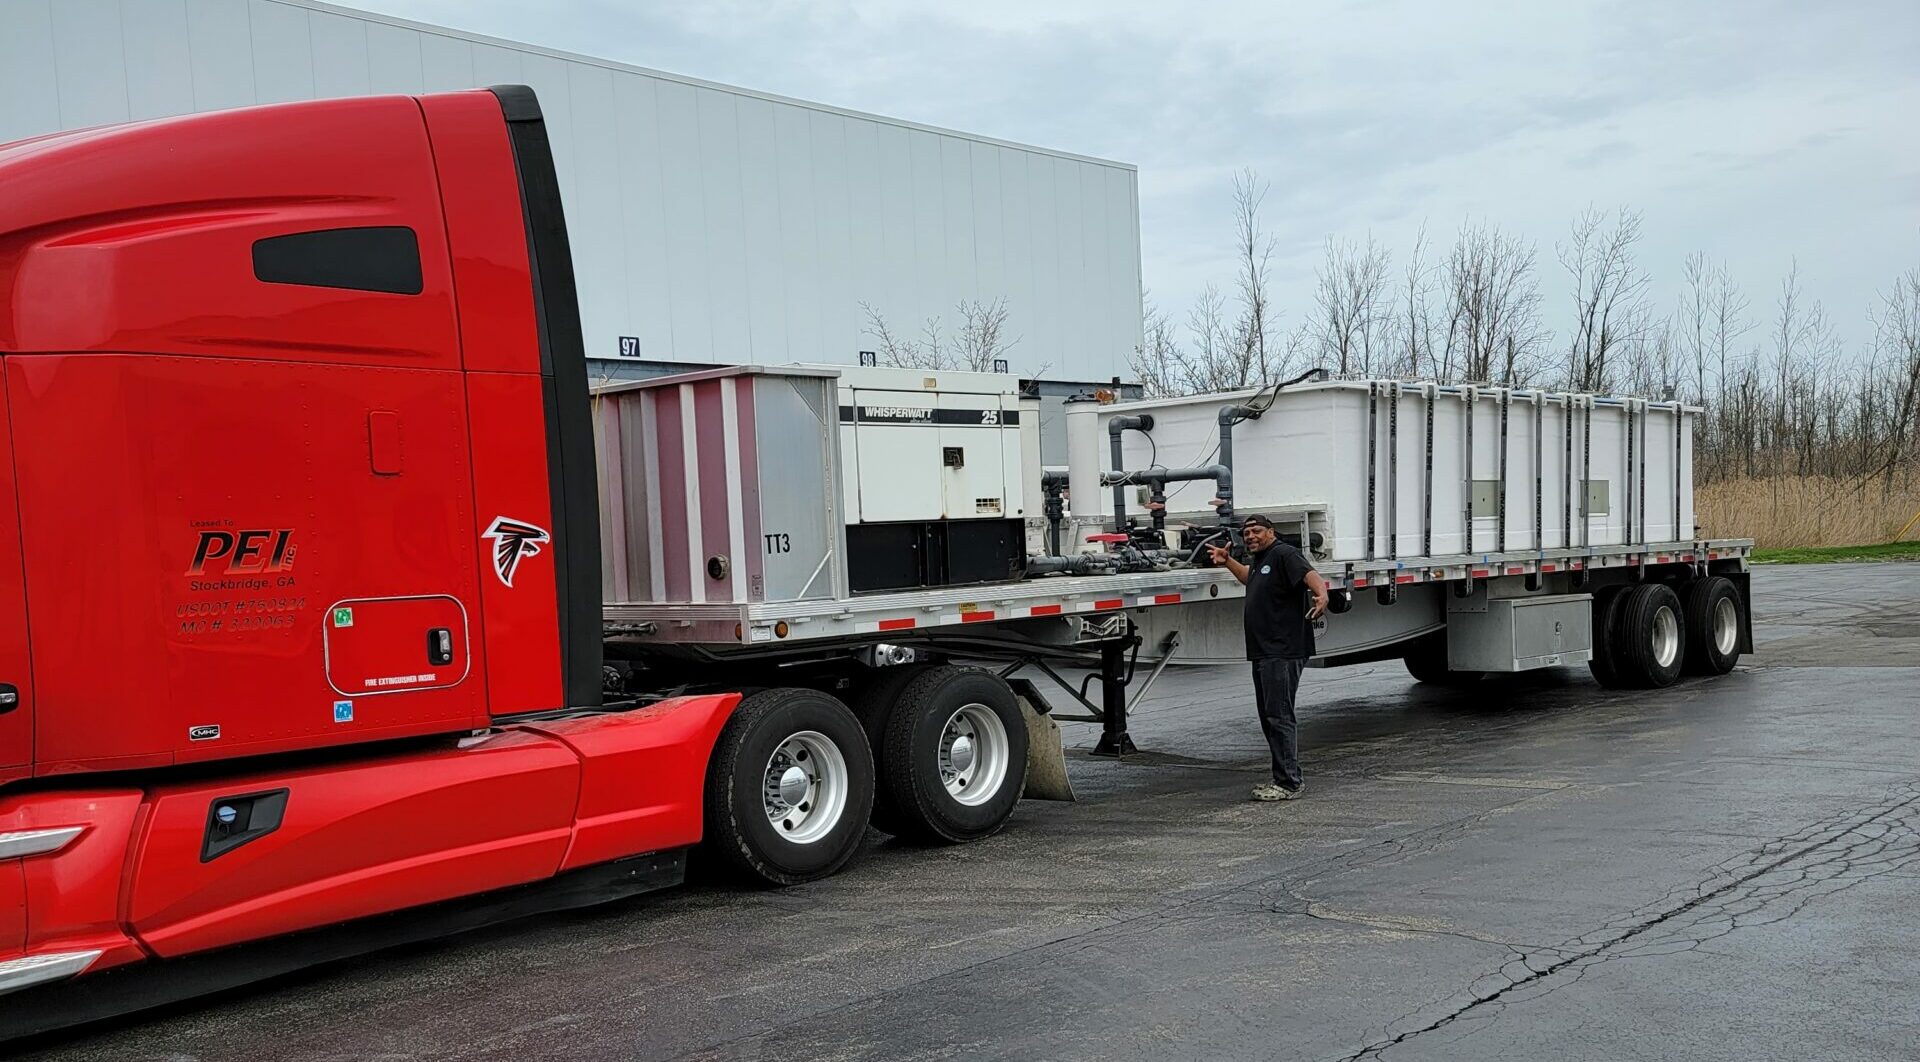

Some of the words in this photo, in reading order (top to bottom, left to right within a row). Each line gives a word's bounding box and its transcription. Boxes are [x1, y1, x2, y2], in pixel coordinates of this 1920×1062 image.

[622, 338, 637, 355] 97
[862, 353, 874, 366] 98
[865, 407, 933, 418] WHISPERWATT
[981, 411, 998, 424] 25
[1389, 388, 1397, 438] KINEDYNE
[224, 519, 234, 527] To
[764, 533, 790, 554] TT3
[184, 528, 295, 577] PEI
[190, 578, 272, 592] Stockbridge,
[276, 576, 296, 587] GA
[176, 600, 231, 617] USDOT
[364, 679, 378, 687] FIRE
[378, 675, 418, 686] EXTINGUISHER
[418, 673, 437, 682] INSIDE
